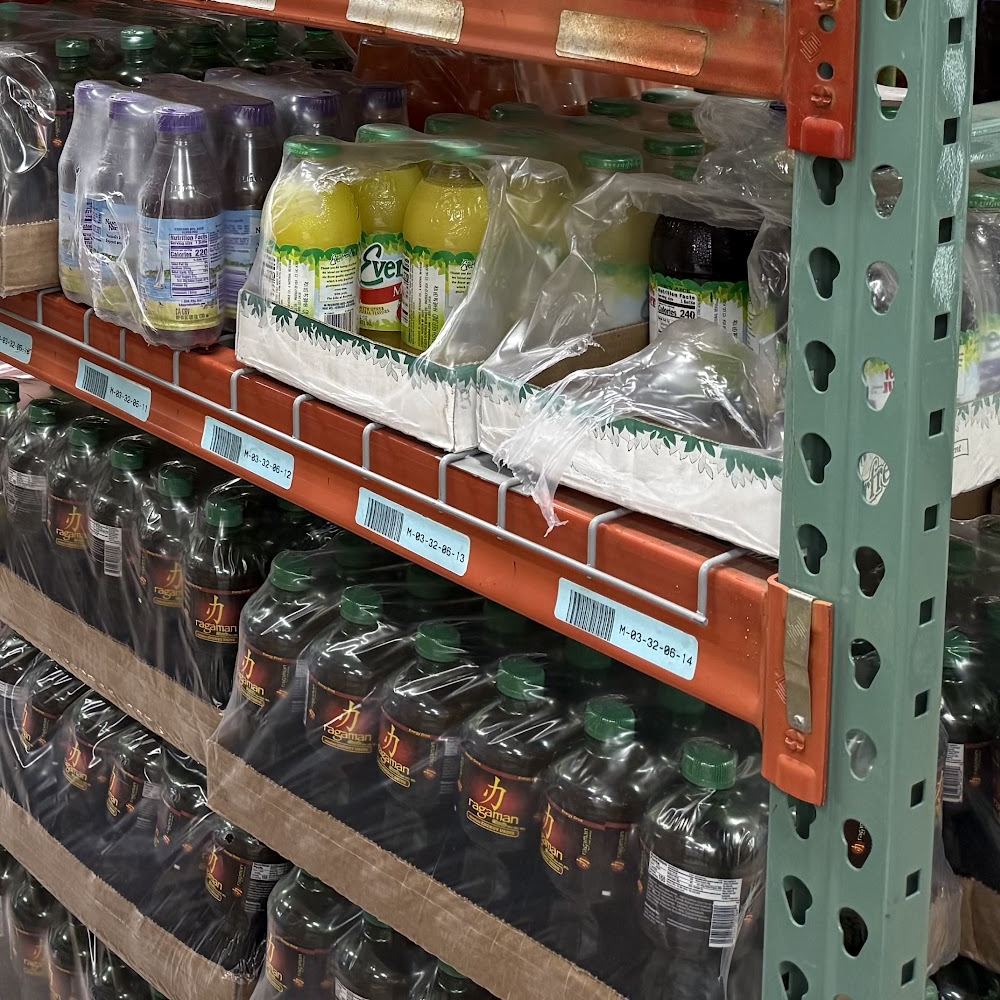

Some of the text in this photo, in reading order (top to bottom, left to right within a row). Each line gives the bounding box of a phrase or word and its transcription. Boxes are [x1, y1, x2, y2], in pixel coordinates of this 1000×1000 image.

[195, 248, 208, 257] 220
[657, 287, 696, 301] Nutrition Facts
[657, 304, 696, 319] Calories 240
[110, 386, 148, 413] M-03-32-06-11
[243, 449, 292, 480] M-03-32-06-12
[406, 526, 466, 564] M-03-32-06-13
[206, 594, 225, 625] 力
[195, 618, 238, 634] ragaman
[619, 623, 694, 667] M-03-32-06-14
[323, 723, 372, 743] ragaman
[483, 775, 507, 812] 力
[468, 797, 519, 826] ragaman
